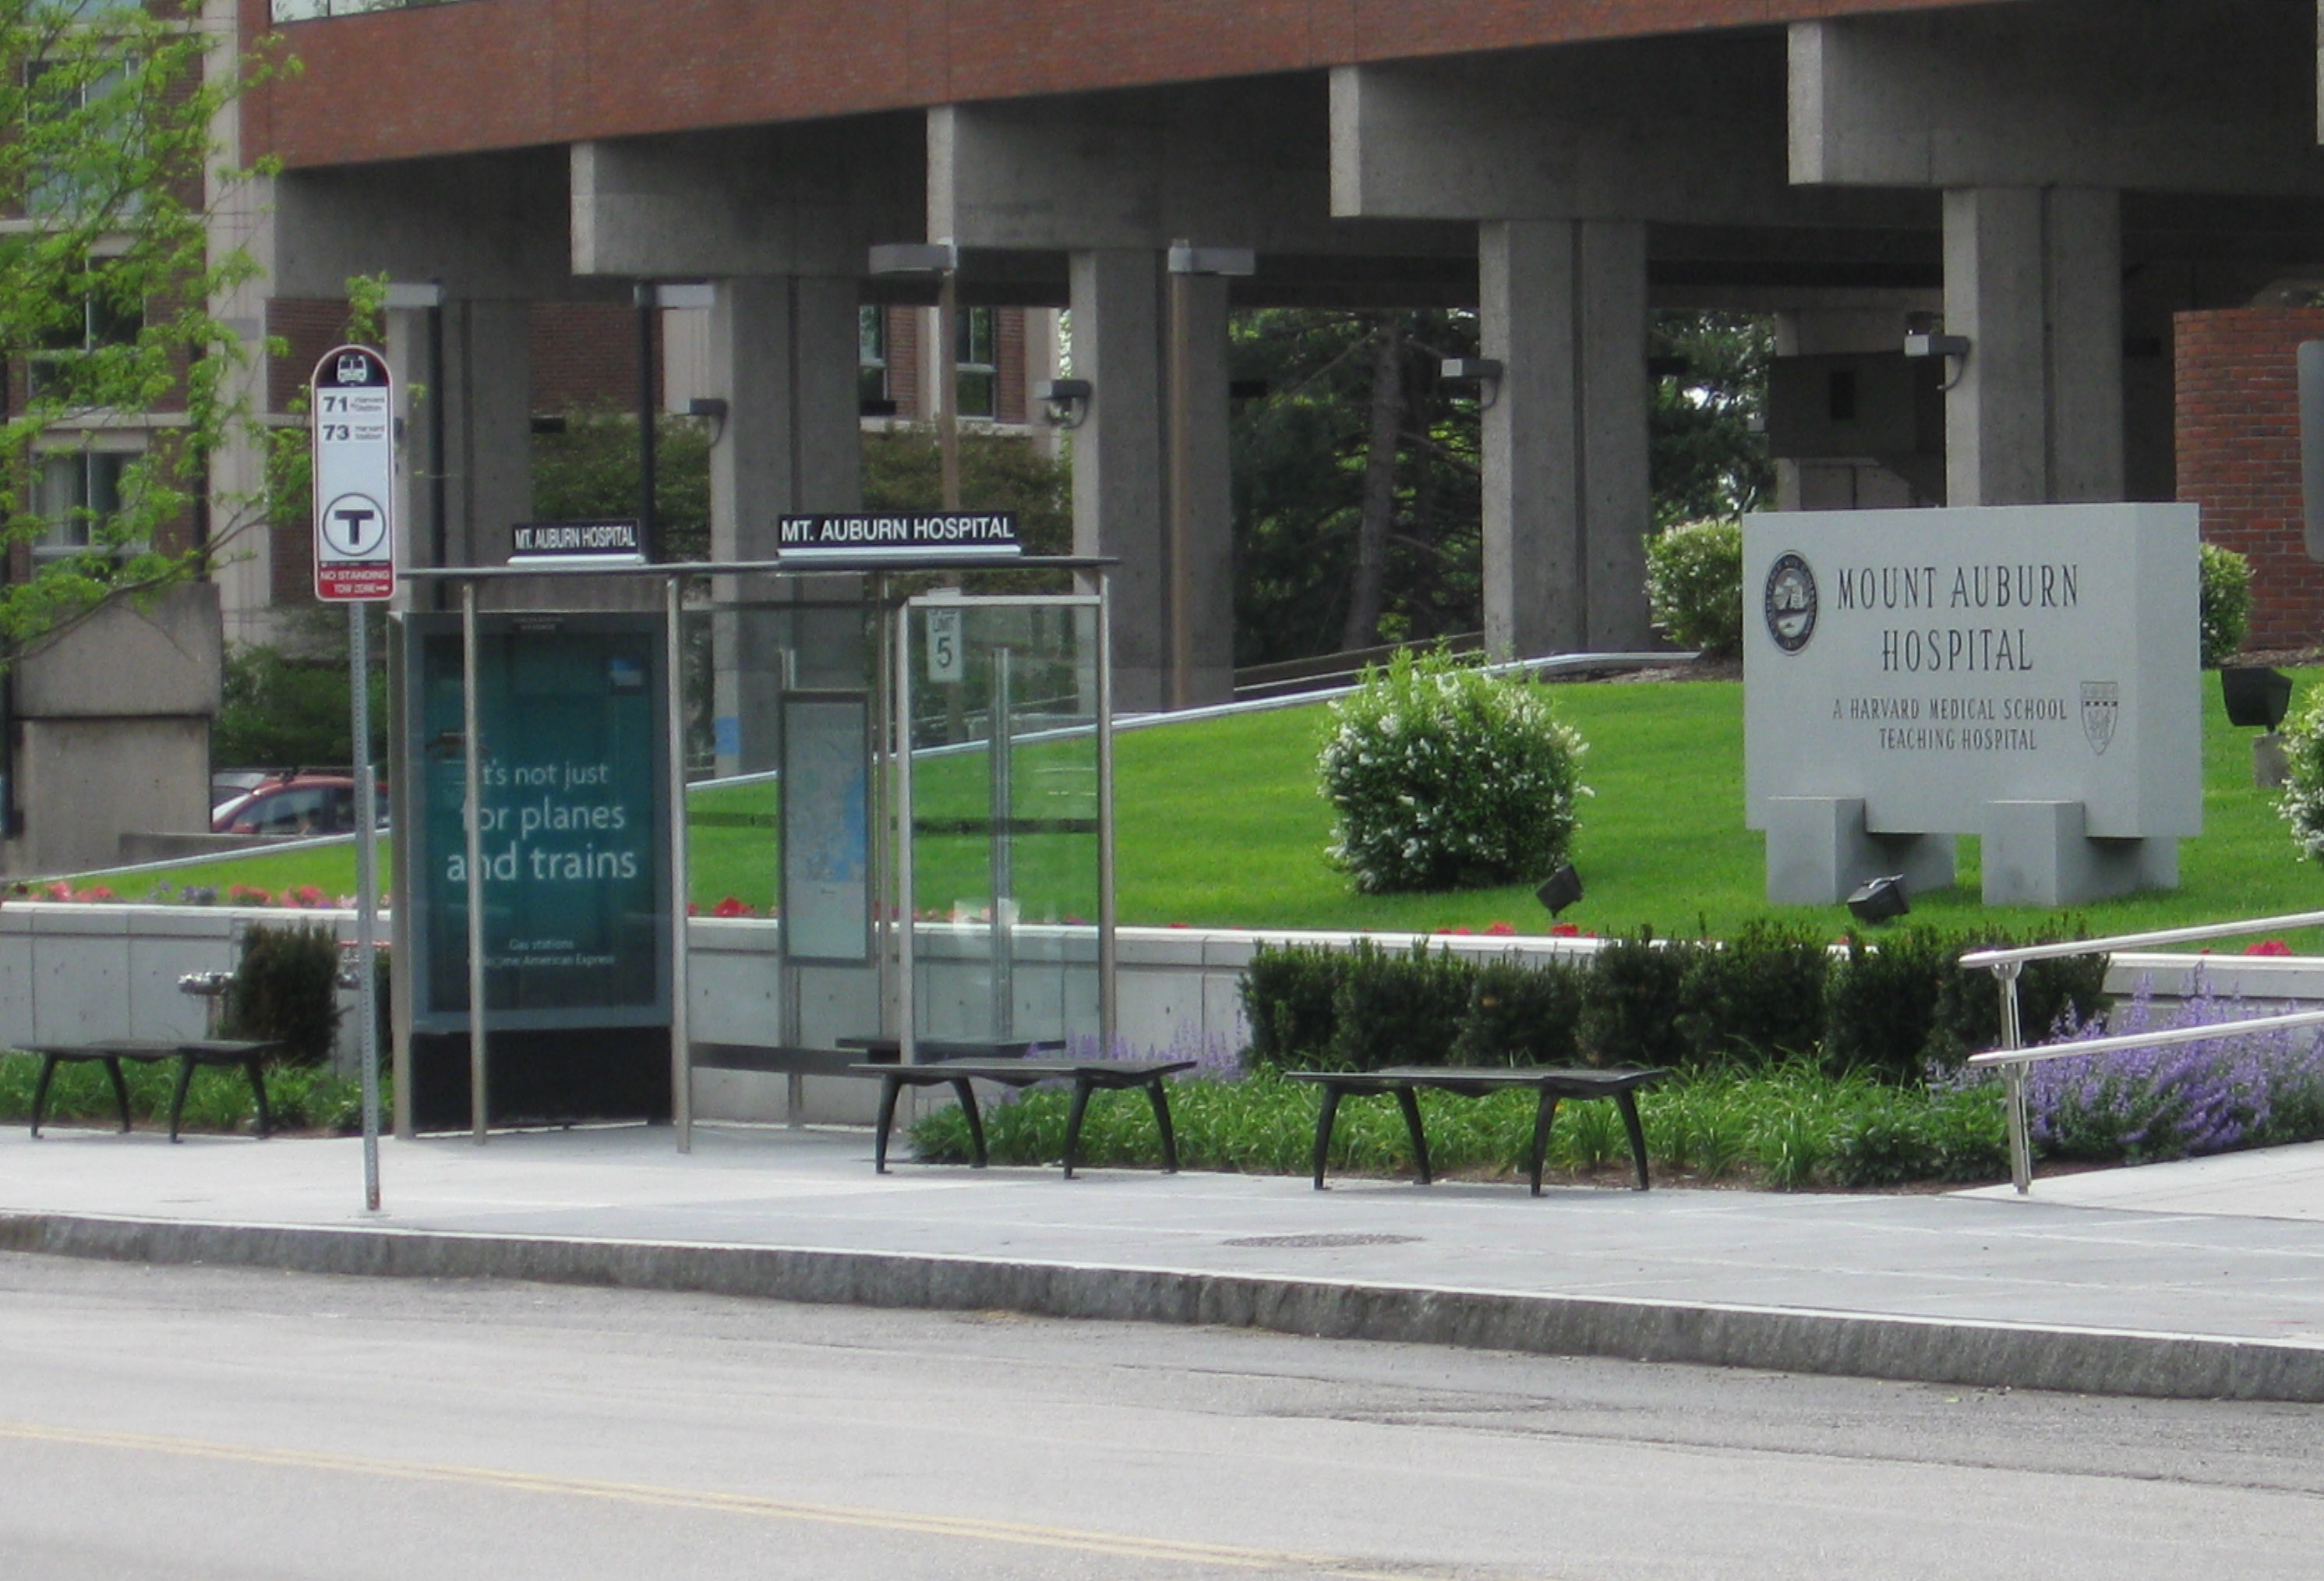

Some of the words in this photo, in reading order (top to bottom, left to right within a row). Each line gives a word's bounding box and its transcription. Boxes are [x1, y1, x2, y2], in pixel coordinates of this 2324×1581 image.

[323, 396, 348, 412] 71
[323, 425, 349, 440] 73
[334, 509, 374, 546] T
[535, 527, 580, 548] AUBURN
[582, 525, 636, 547] HOSPITAL
[781, 519, 814, 542] MT.
[820, 518, 907, 541] AUBURN
[913, 517, 1015, 539] HOSPITAL
[320, 570, 337, 580] NO
[337, 569, 390, 580] STANDING
[1837, 566, 1937, 610] MOUNT
[1951, 564, 2079, 608] AUBURN
[937, 636, 952, 669] 5
[1882, 628, 2033, 671] HOSPITAL
[1833, 699, 1842, 720] A
[1850, 699, 1920, 720] HARVARD
[1929, 699, 1996, 720] MEDICAL
[2004, 699, 2068, 720] SCHOOL
[1879, 728, 1955, 750] TEACHING
[1962, 728, 2037, 751] HOSPITAL
[481, 759, 507, 784] t's
[515, 763, 557, 784] not
[564, 762, 609, 791] just
[521, 795, 626, 840] planes
[530, 843, 638, 881] trains
